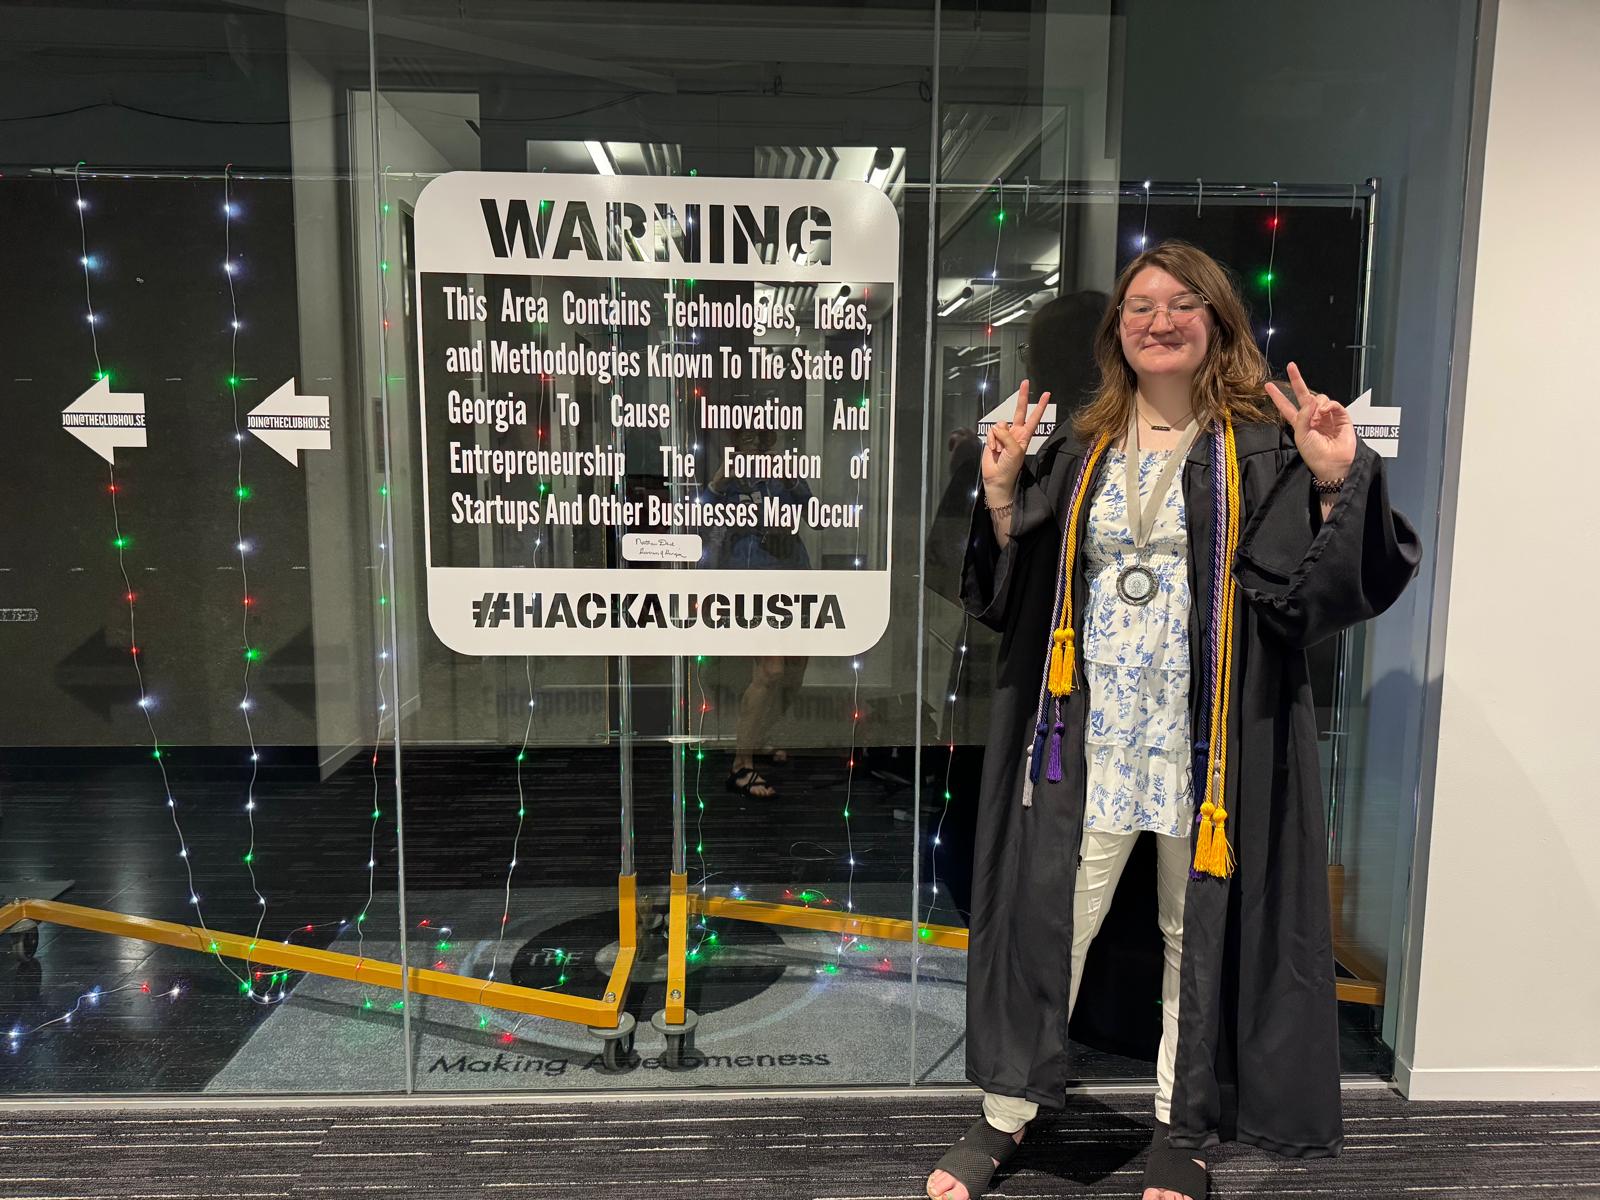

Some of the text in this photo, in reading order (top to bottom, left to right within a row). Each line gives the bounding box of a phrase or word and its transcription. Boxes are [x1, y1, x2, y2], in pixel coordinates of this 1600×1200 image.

[479, 198, 833, 267] WARNING
[442, 286, 873, 336] This Area Contains Technologies, Ideas,
[446, 341, 872, 384] and Methodologies Known To The State Of
[62, 413, 146, 427] JOIN@THECLUBHOU.SE
[247, 415, 330, 429] JOIN@THECLUBHOU.SE
[447, 390, 870, 432] Georgia To Cause Innovation And
[449, 441, 870, 482] Entrepreneurship The Formation of
[451, 493, 863, 535] Startups And Other Businesses May Occur
[472, 592, 846, 630] #HACKAUGUSTA
[429, 1053, 568, 1076] Making
